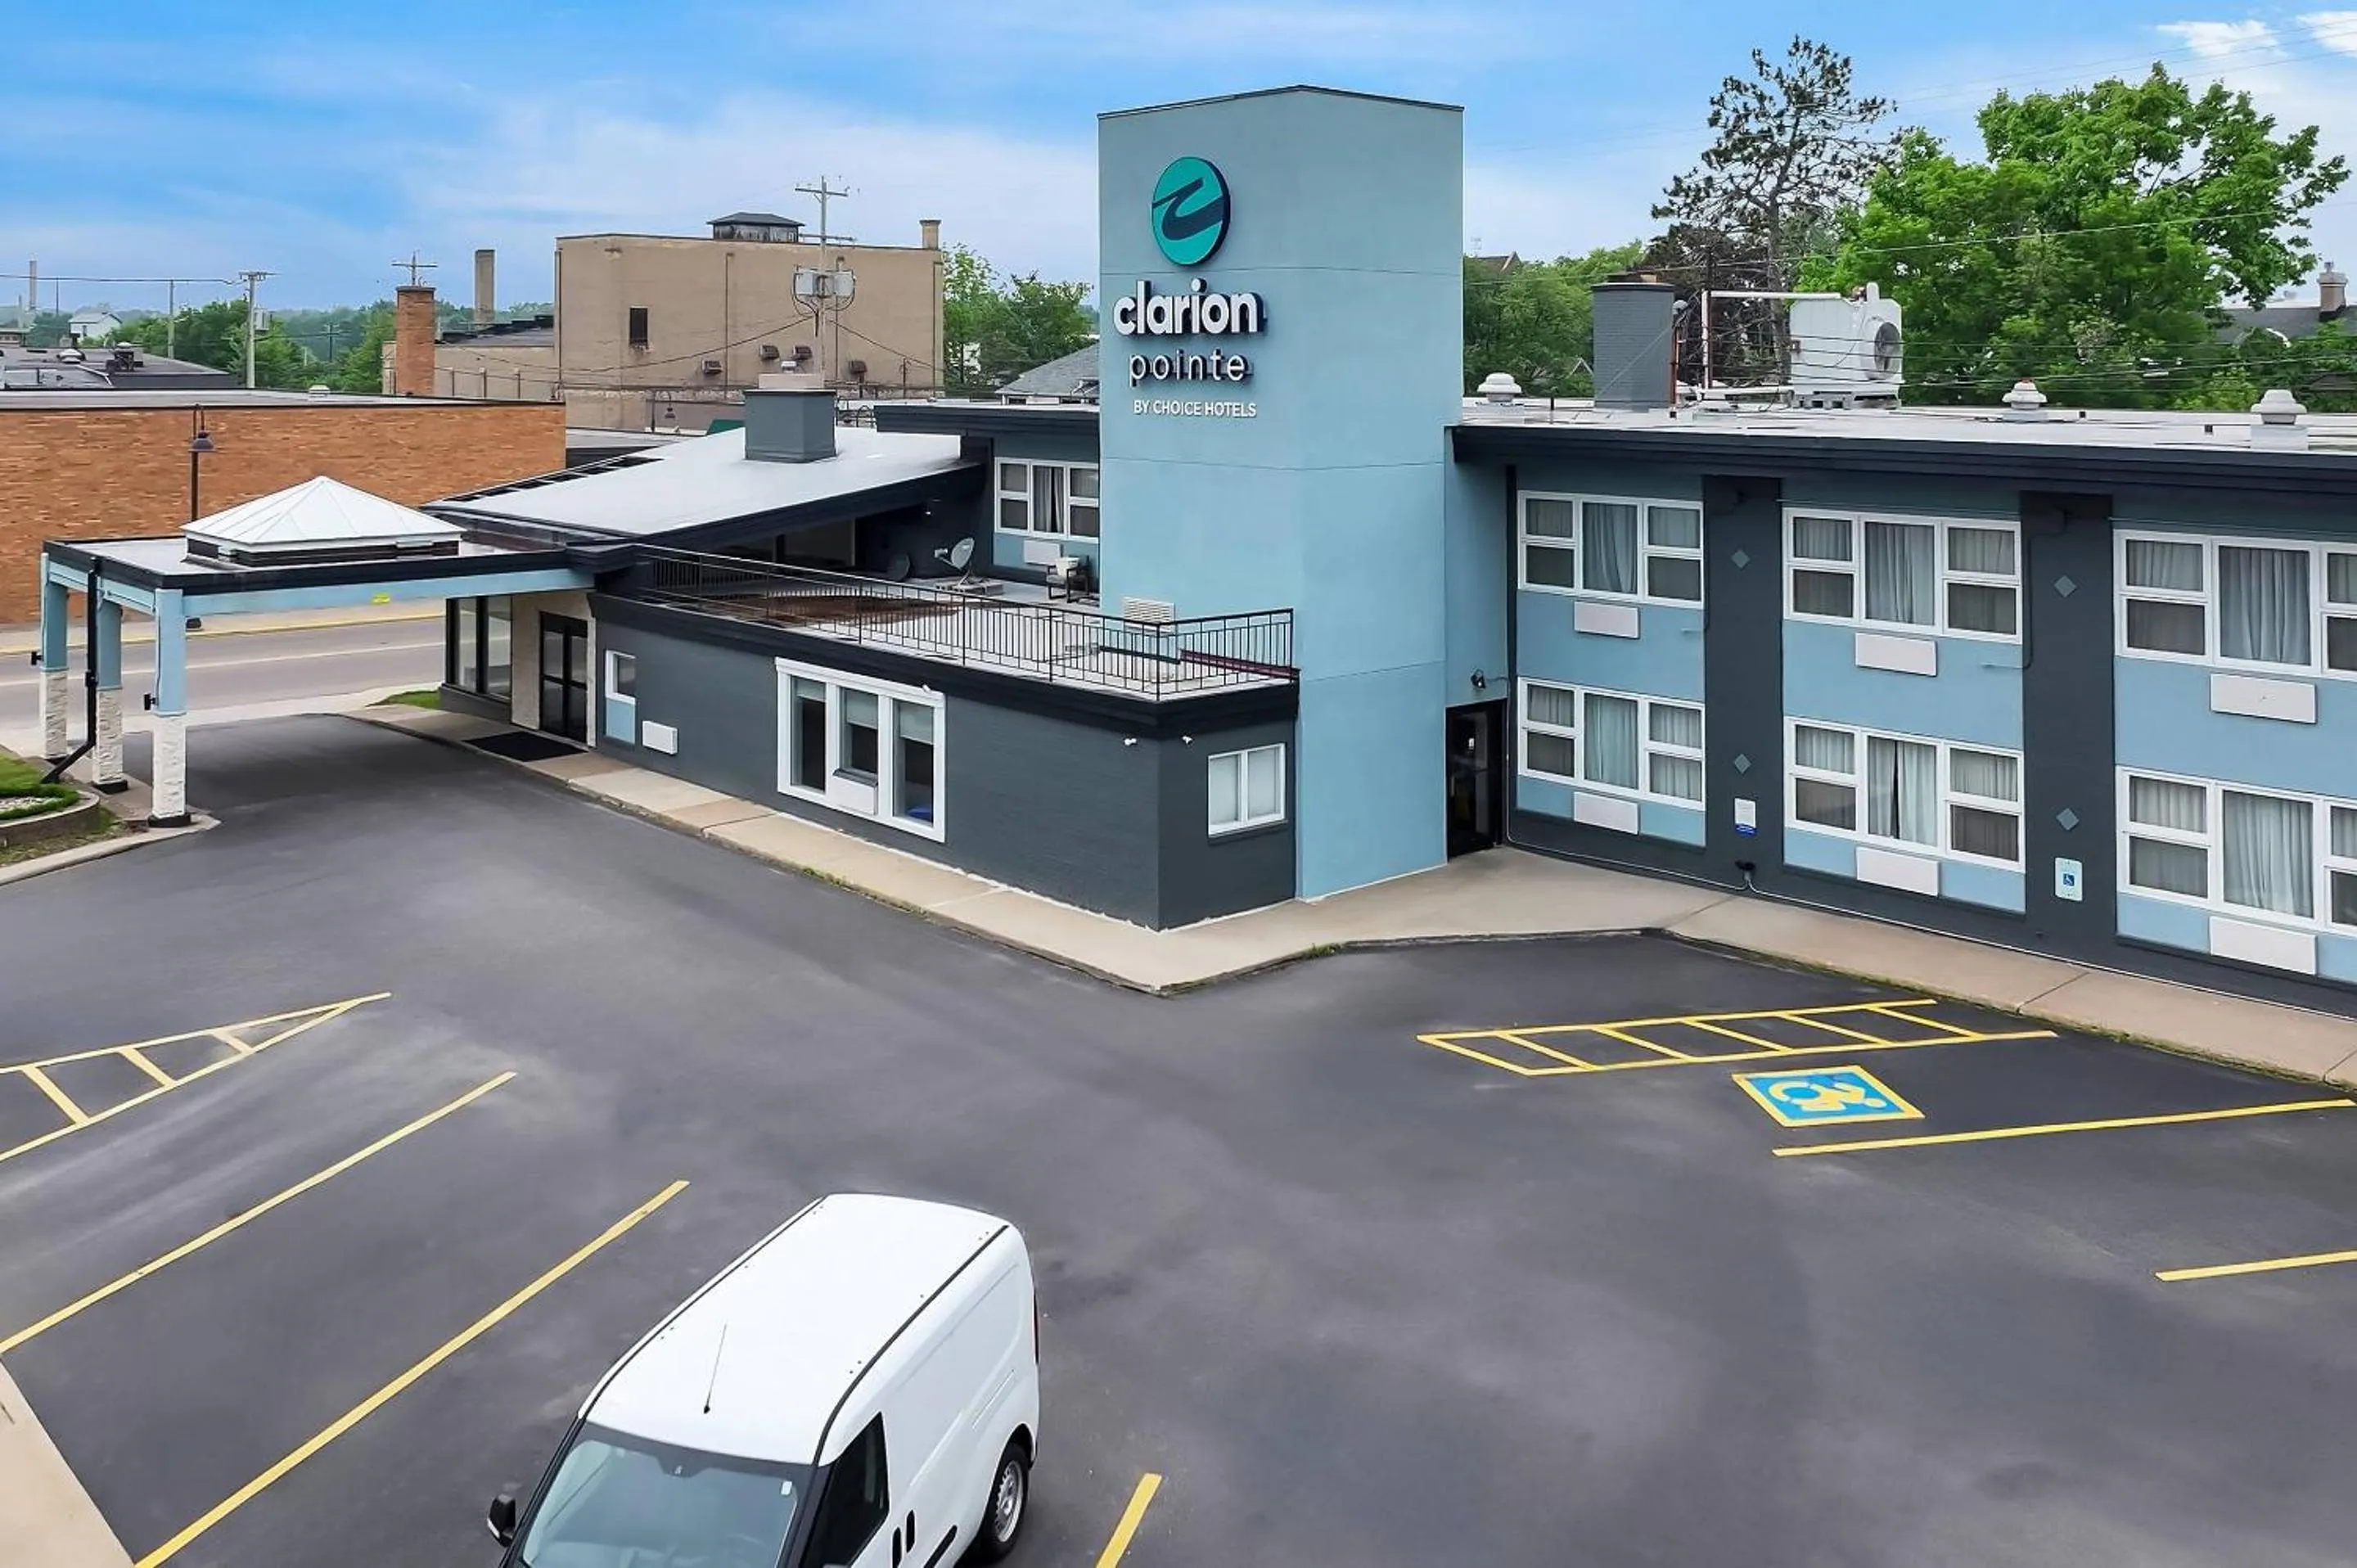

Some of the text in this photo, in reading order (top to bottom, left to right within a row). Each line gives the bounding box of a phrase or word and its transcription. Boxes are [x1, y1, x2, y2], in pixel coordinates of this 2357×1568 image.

[1114, 277, 1260, 335] clarion
[1129, 349, 1248, 387] pointe
[1133, 399, 1256, 417] BY CHOICE HOTELS
